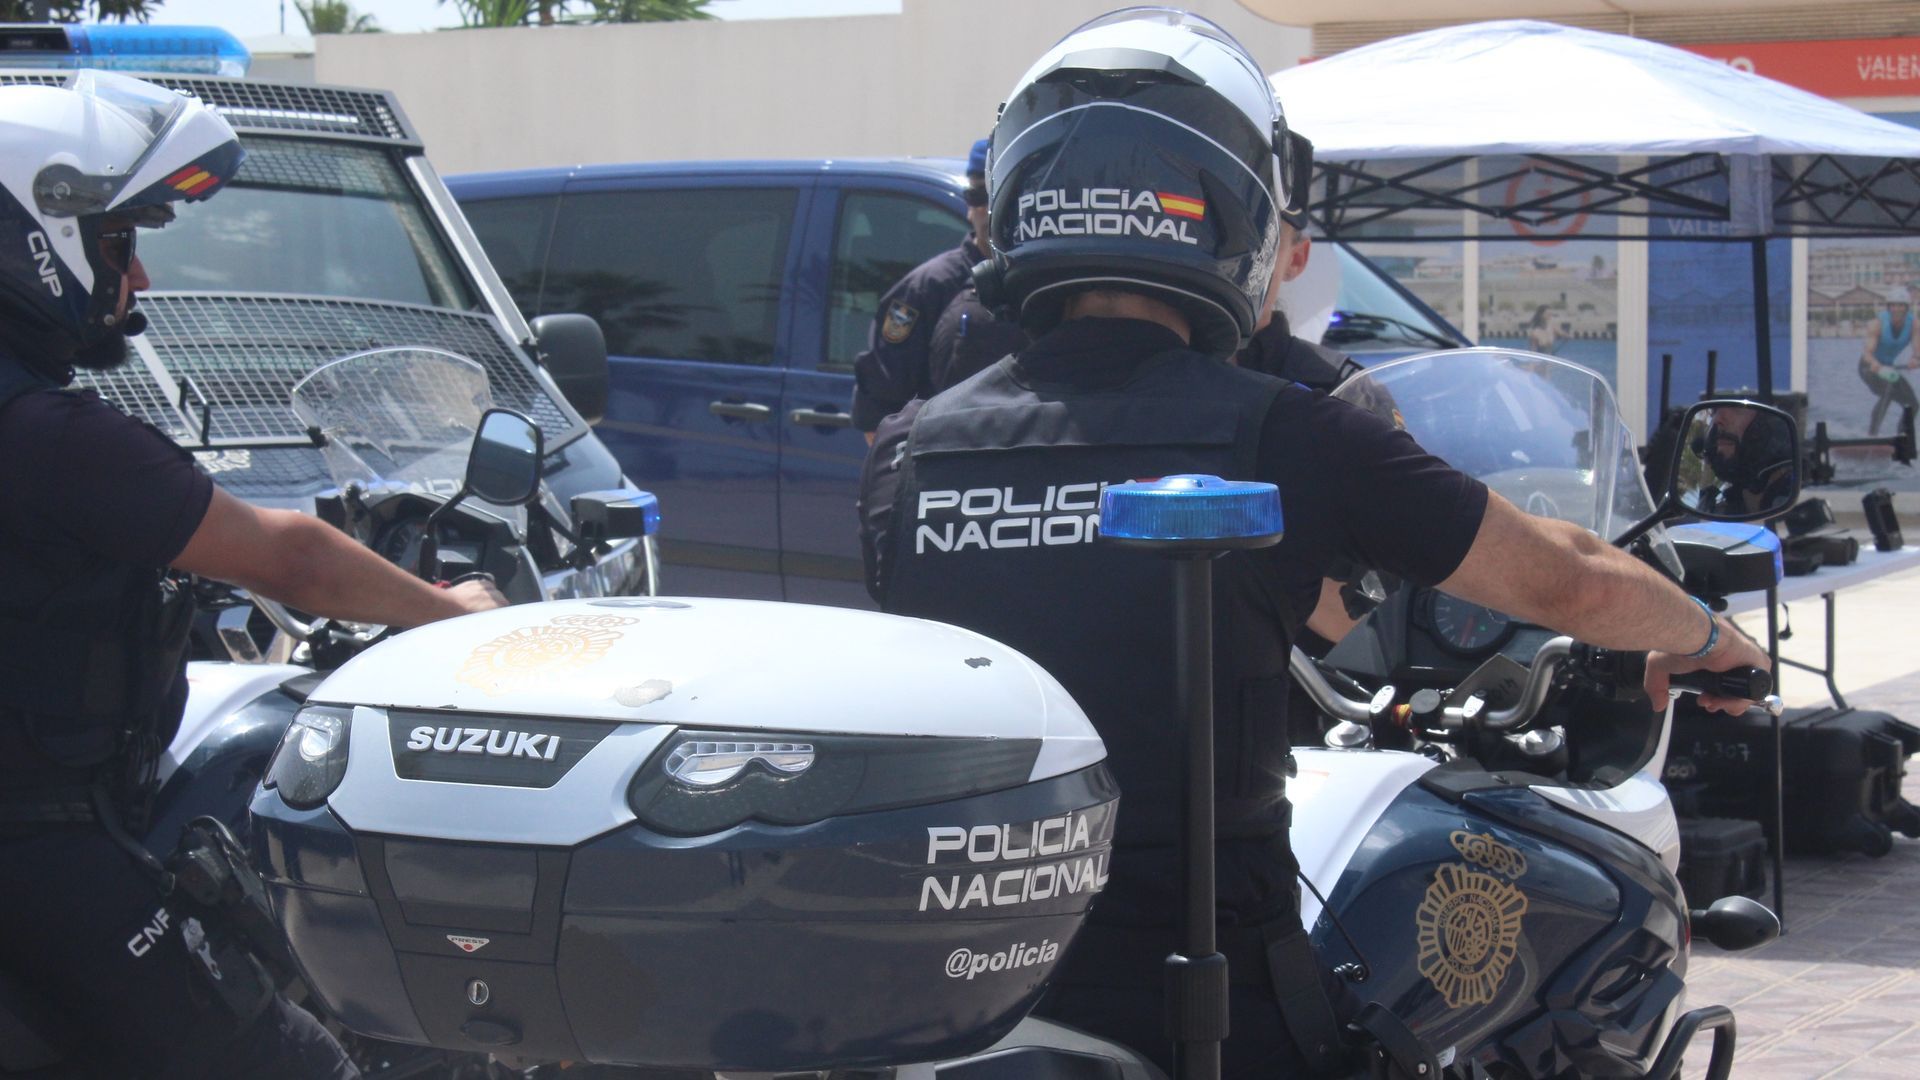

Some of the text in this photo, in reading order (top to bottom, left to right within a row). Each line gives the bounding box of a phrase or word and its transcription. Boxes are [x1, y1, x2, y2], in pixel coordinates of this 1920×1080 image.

[1019, 213, 1198, 245] NACIONAL
[27, 230, 63, 297] CNP
[407, 726, 561, 762] SUZUKI
[927, 811, 1090, 864] POLICÍA
[918, 855, 1110, 911] NACIONAL
[945, 939, 1059, 980] @policia
